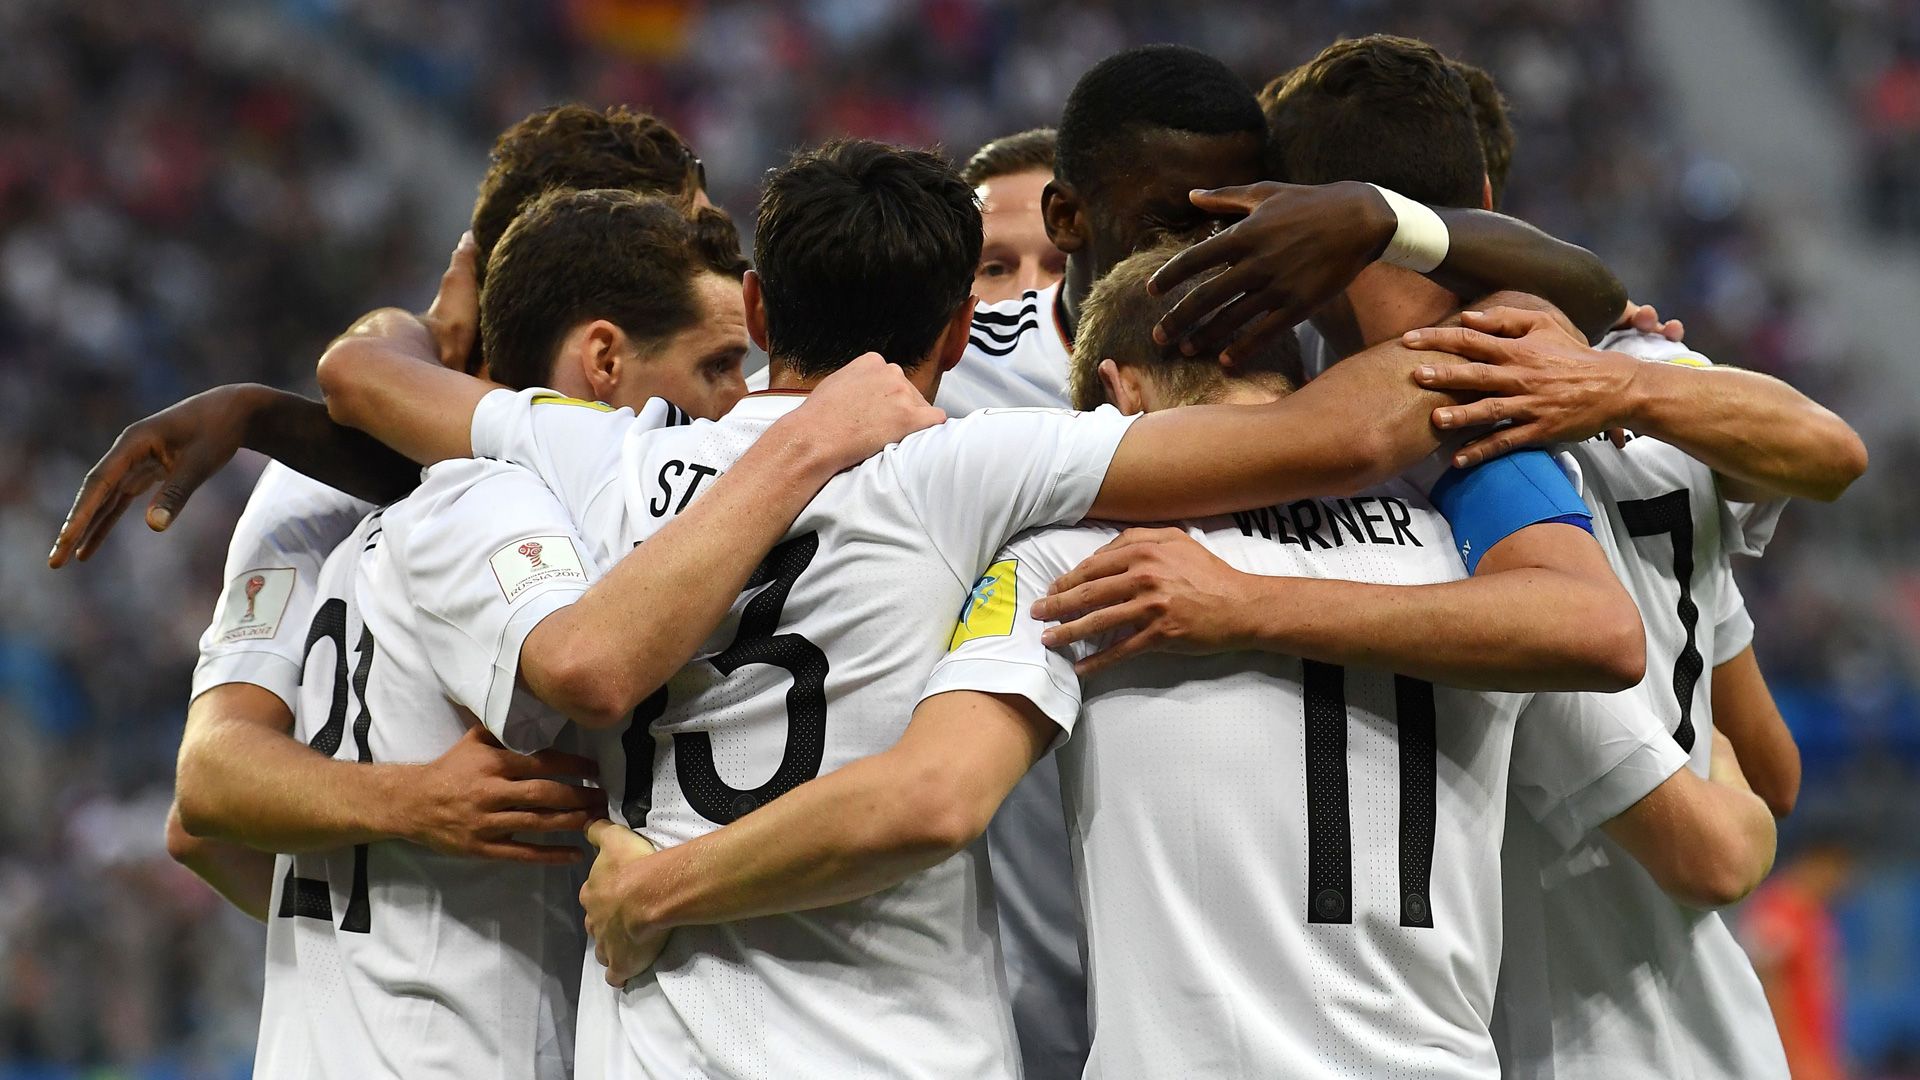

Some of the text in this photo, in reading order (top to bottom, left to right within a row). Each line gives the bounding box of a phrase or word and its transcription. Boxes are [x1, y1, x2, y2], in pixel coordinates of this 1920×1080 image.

[649, 459, 725, 518] ST
[1231, 496, 1425, 552] WERNER
[510, 573, 553, 597] RUSSIA
[1617, 488, 1704, 754] 7
[277, 597, 376, 935] 21
[1301, 657, 1437, 928] 11
